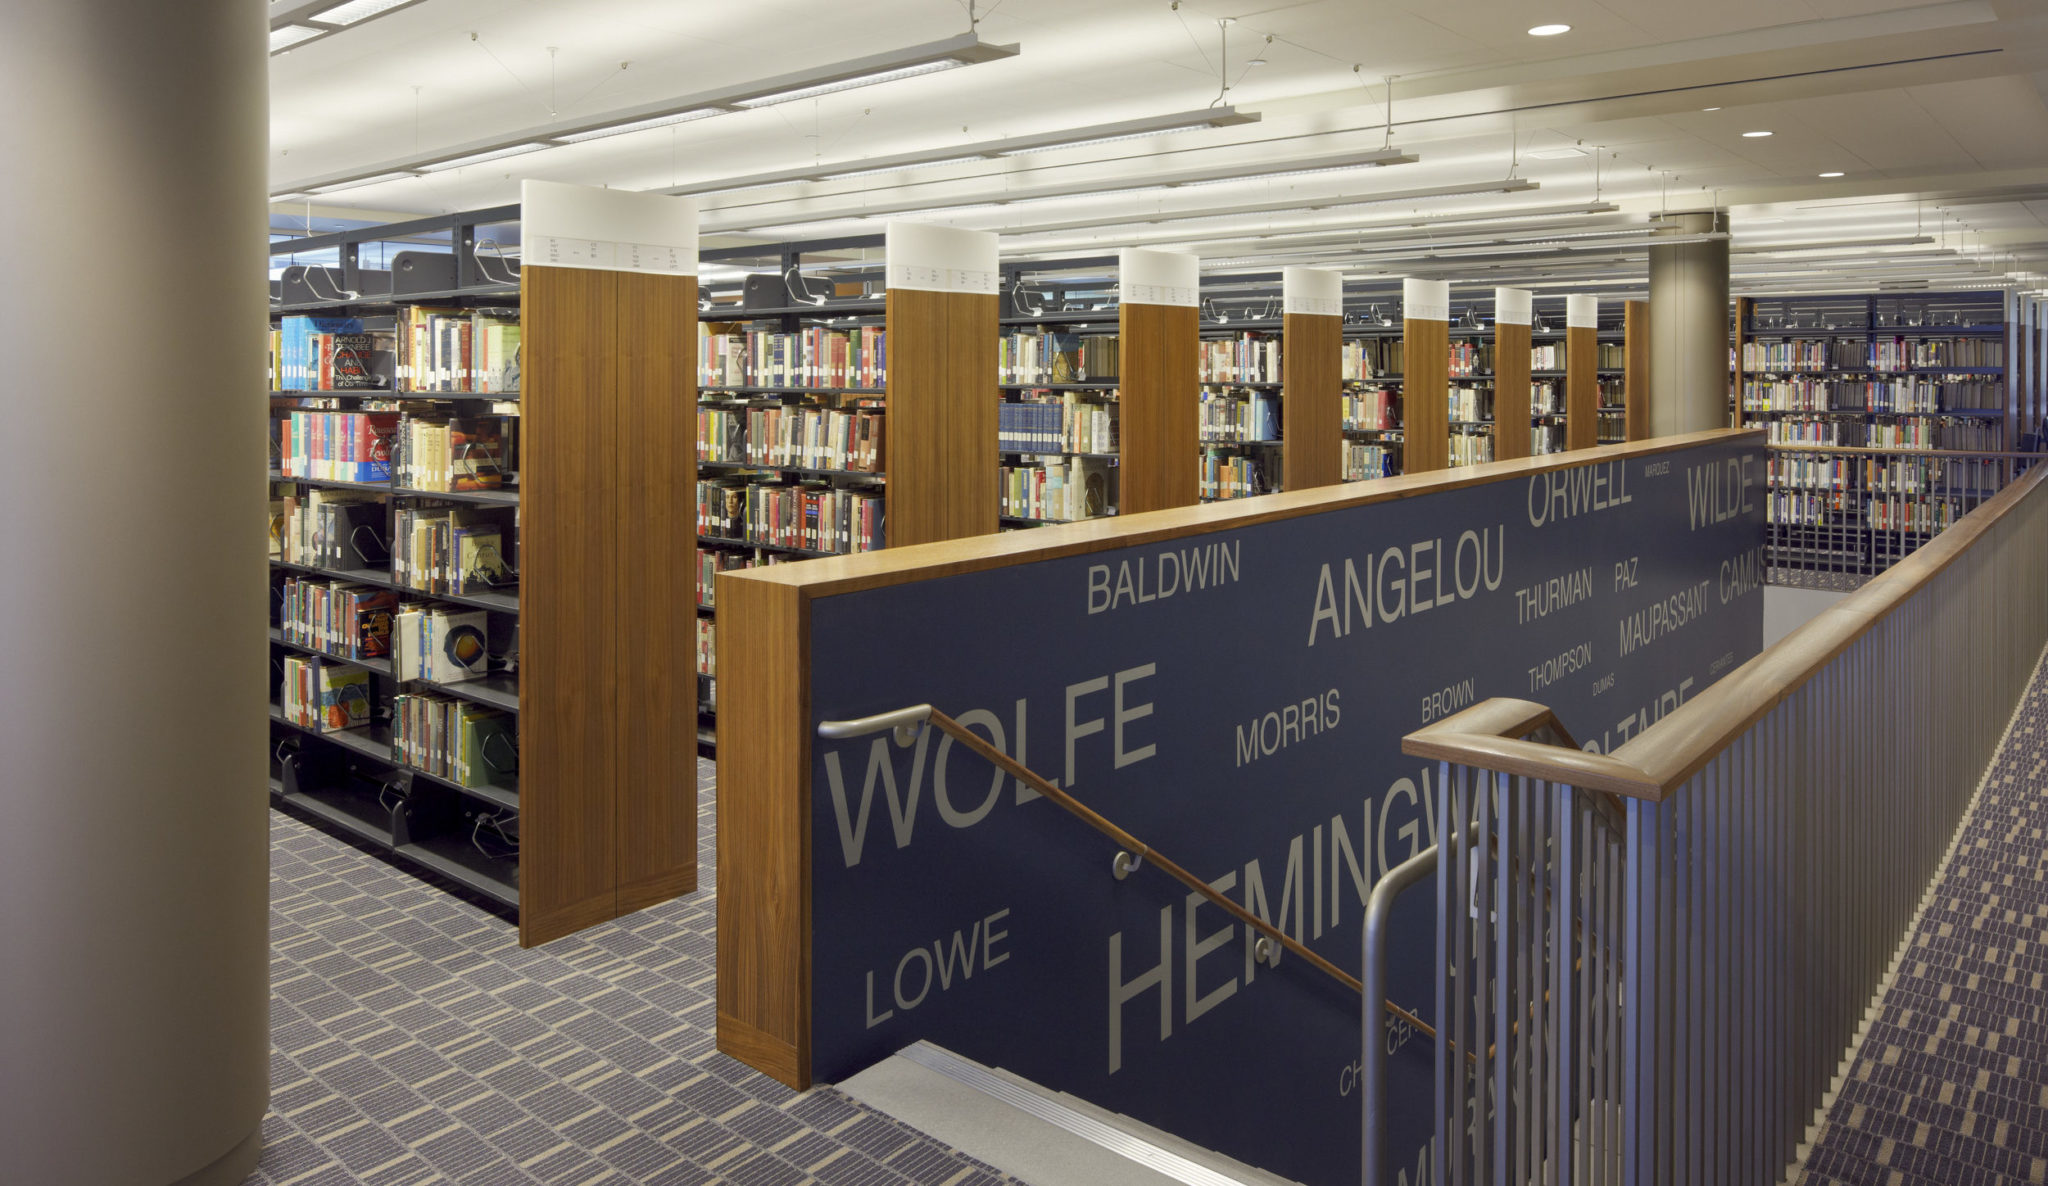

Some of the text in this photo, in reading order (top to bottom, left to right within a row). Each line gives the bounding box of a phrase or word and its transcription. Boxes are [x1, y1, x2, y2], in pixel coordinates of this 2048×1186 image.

[335, 336, 366, 344] ARNOLD
[335, 343, 371, 351] TNBEE
[1528, 458, 1633, 528] ORWELL
[1687, 454, 1754, 532] WILDE
[1087, 539, 1241, 615] BALDWIN
[1308, 523, 1504, 647] ANGELOU
[1515, 566, 1593, 625] THURMAN
[1614, 556, 1639, 593] PAZ
[1720, 543, 1766, 605] CAMUS
[1619, 580, 1710, 658] MAUPASSANT
[1422, 676, 1474, 724] BROWN
[1528, 641, 1592, 693] THOMPSON
[1592, 672, 1615, 697] DUMAS
[1236, 687, 1341, 768] MORRIS
[823, 661, 1157, 868] WOLFE
[1108, 764, 1500, 1075] HEMINGW
[865, 907, 1010, 1030] LOWE
[1340, 1008, 1418, 1097] CHCER
